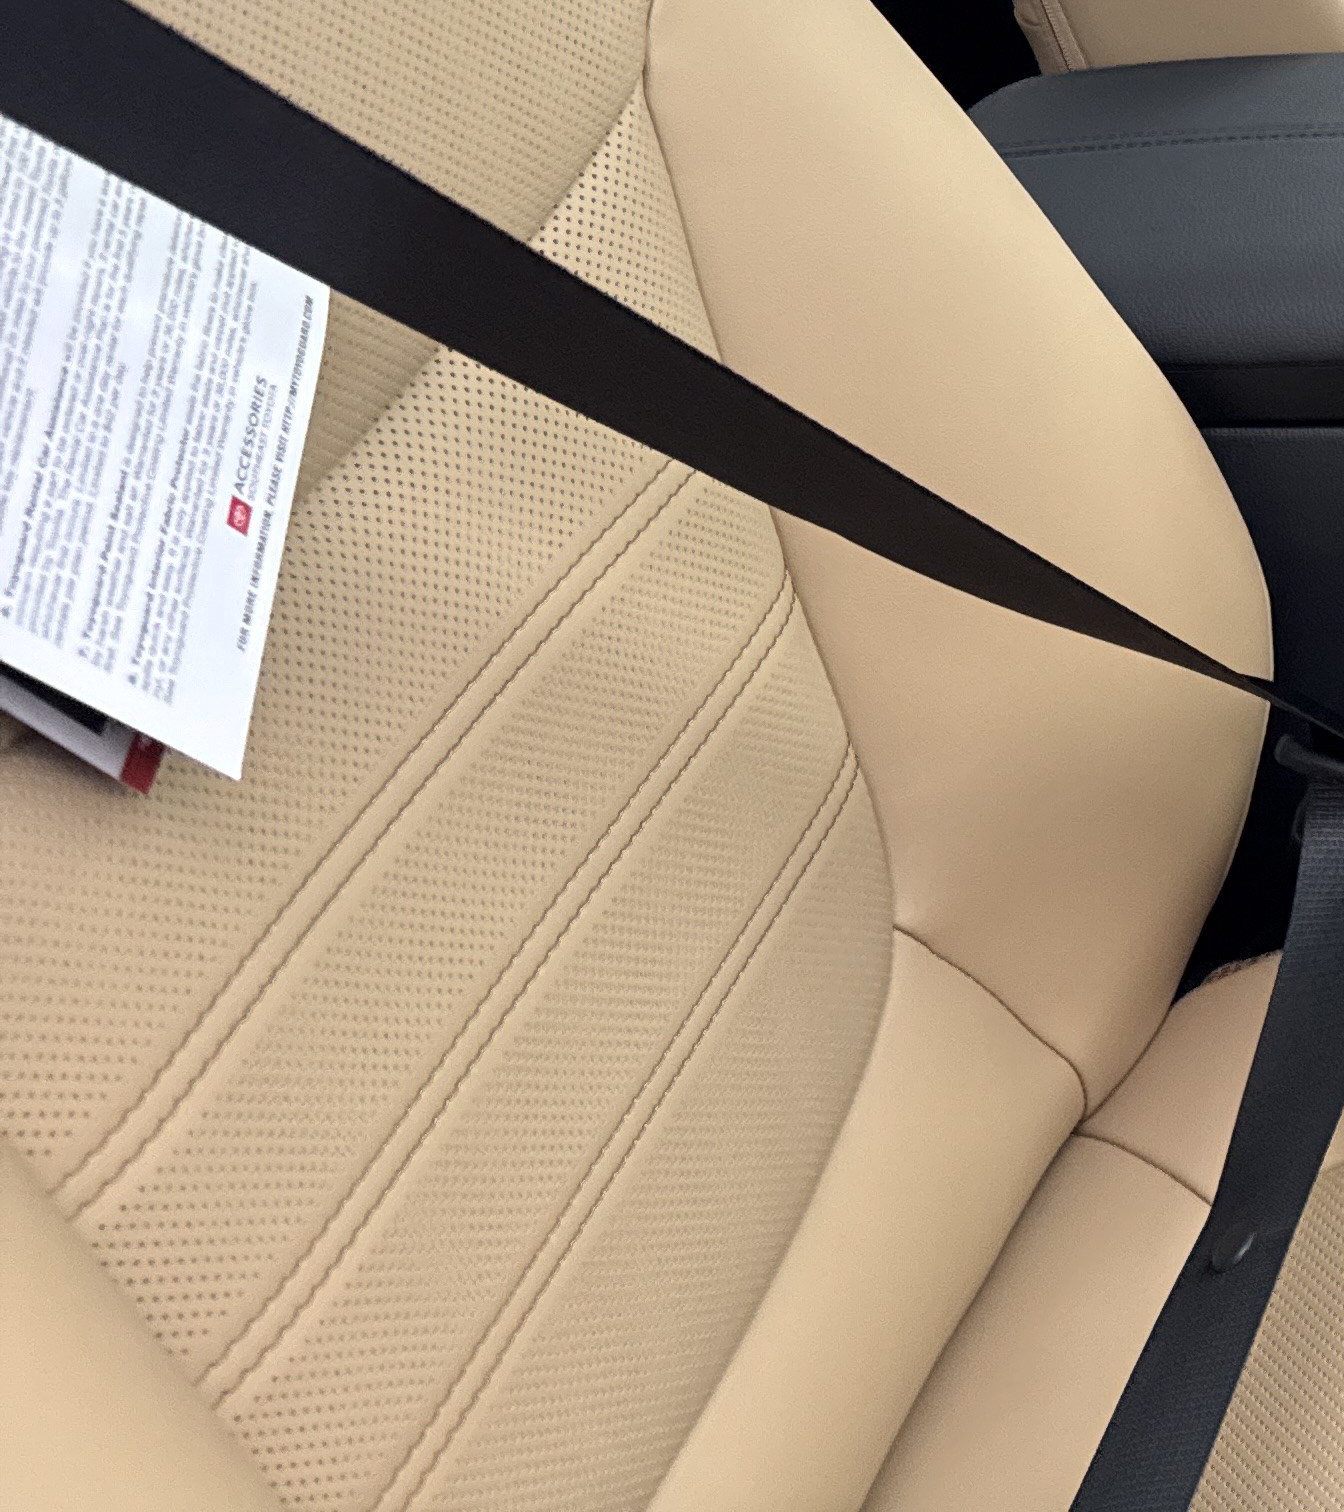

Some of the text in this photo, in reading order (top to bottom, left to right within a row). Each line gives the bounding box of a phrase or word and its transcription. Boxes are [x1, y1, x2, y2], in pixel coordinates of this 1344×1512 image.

[234, 375, 267, 495] ACCESSORIES
[275, 434, 288, 463] VISIT
[265, 464, 282, 506] PLEASE
[242, 590, 257, 626] MORE
[237, 627, 249, 652] FOR
